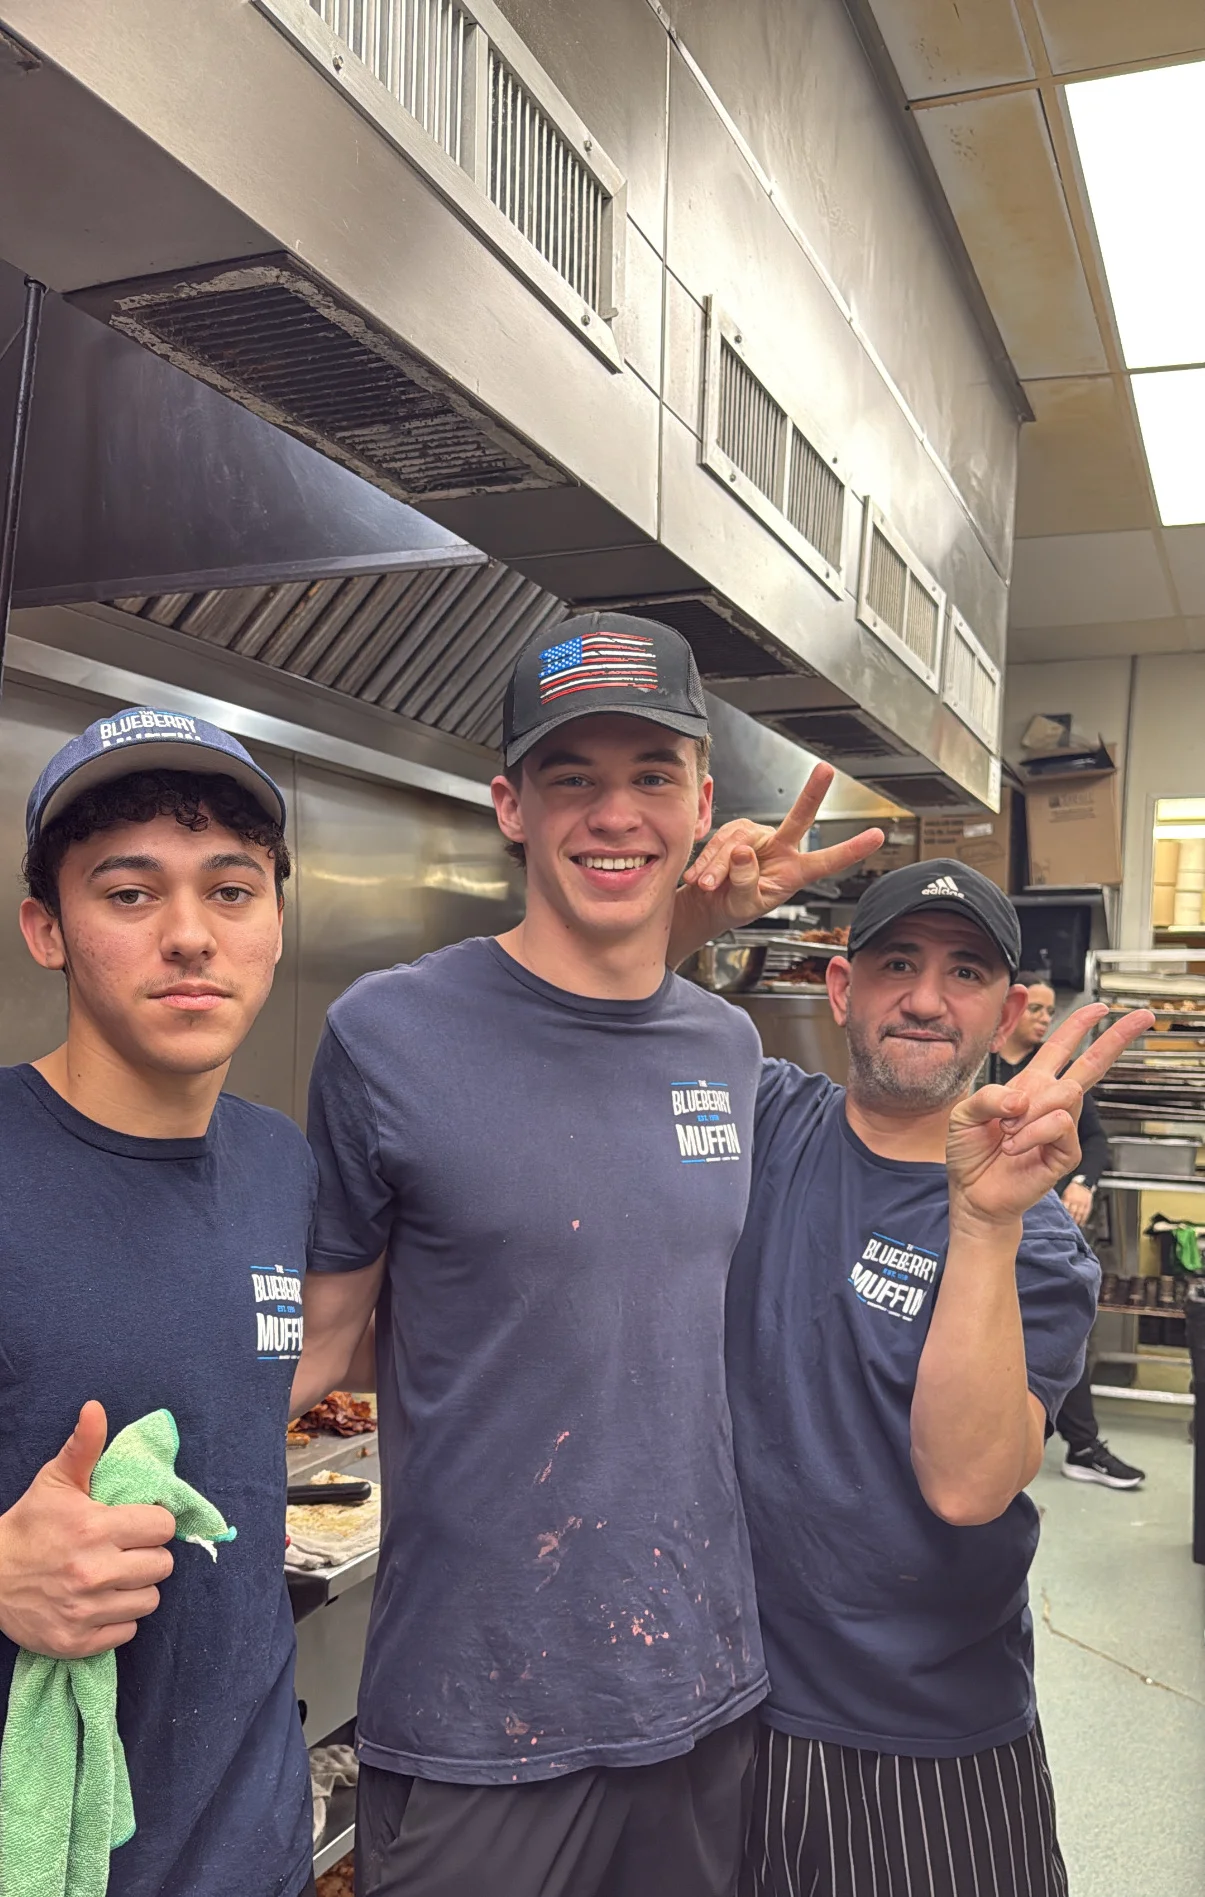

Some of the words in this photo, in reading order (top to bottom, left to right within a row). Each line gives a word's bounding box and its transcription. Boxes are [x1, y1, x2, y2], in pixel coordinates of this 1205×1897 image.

[100, 714, 197, 740] BLUEBERRY
[671, 1089, 732, 1116] BLUEBERRY
[675, 1123, 741, 1157] MUFFIN
[862, 1238, 937, 1284] BLUEBERRY
[251, 1273, 302, 1305] BLUEBERR
[850, 1261, 928, 1316] MUFFIN
[256, 1312, 304, 1352] MUFFI
